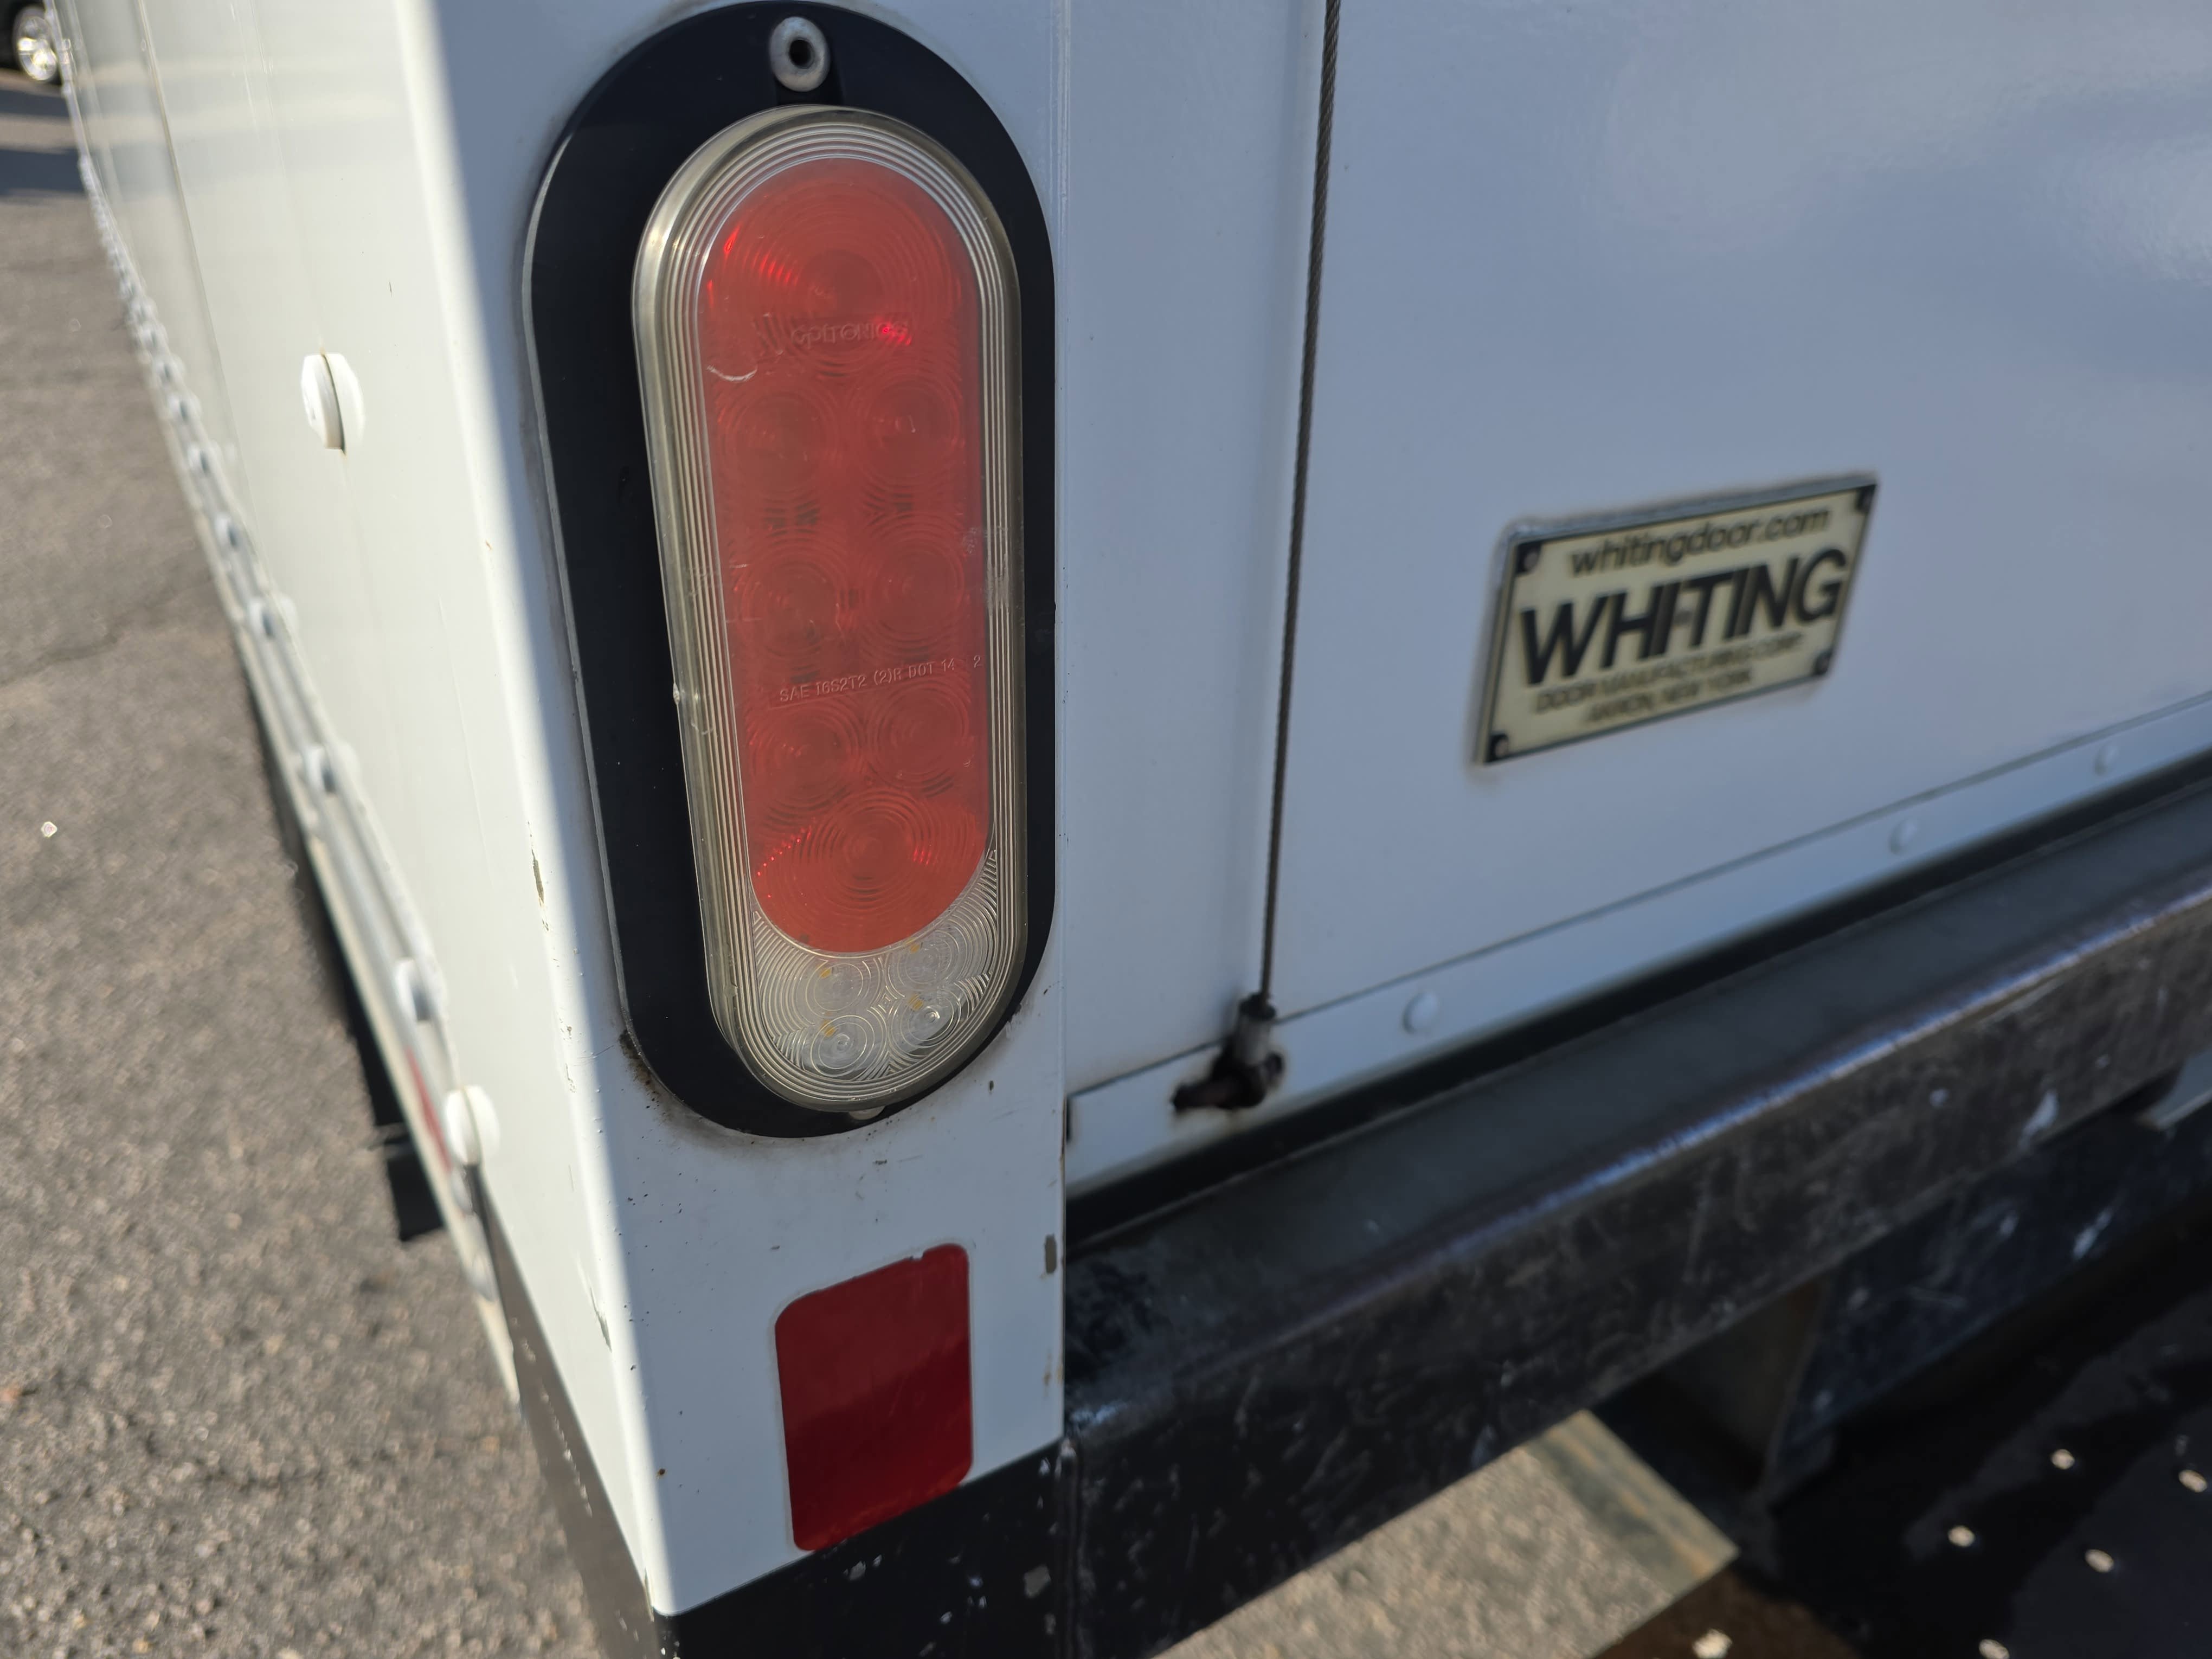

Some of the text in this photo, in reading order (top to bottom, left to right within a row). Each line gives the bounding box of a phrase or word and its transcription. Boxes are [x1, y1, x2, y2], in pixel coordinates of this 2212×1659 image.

[1568, 509, 1831, 576] whitingdoor.com
[1521, 548, 1847, 685] WHITING
[780, 683, 810, 702] SAE
[909, 661, 935, 679] DOT
[941, 658, 955, 671] 14
